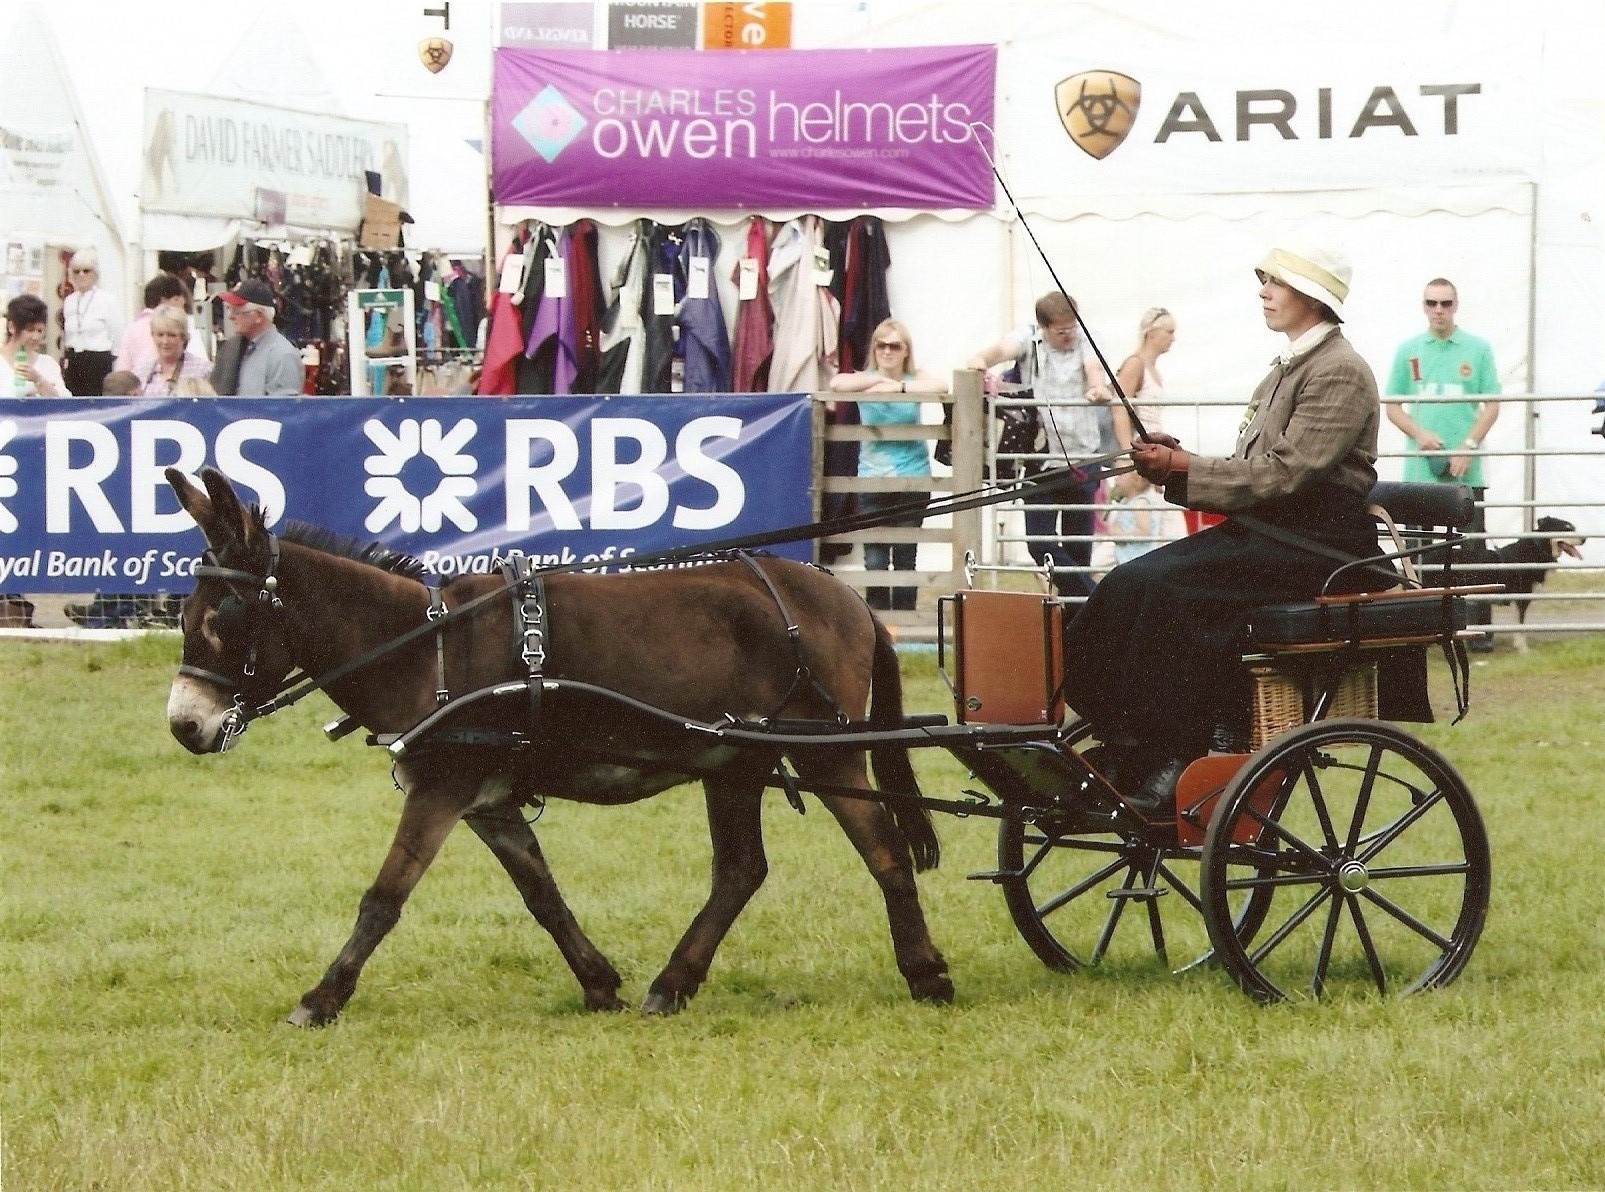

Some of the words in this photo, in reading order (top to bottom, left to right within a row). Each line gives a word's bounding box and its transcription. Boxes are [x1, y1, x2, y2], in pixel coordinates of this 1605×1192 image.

[424, 2, 449, 30] T
[624, 14, 677, 30] HORSE
[593, 90, 756, 116] CHARLES
[768, 91, 971, 143] helmets
[1154, 83, 1482, 143] ARIAT
[185, 115, 238, 165] DAVID
[593, 117, 756, 158] owen
[46, 418, 286, 534] RBS
[505, 415, 746, 532] RBS
[0, 549, 41, 584] yal
[47, 551, 117, 577] Bank
[124, 550, 158, 585] of
